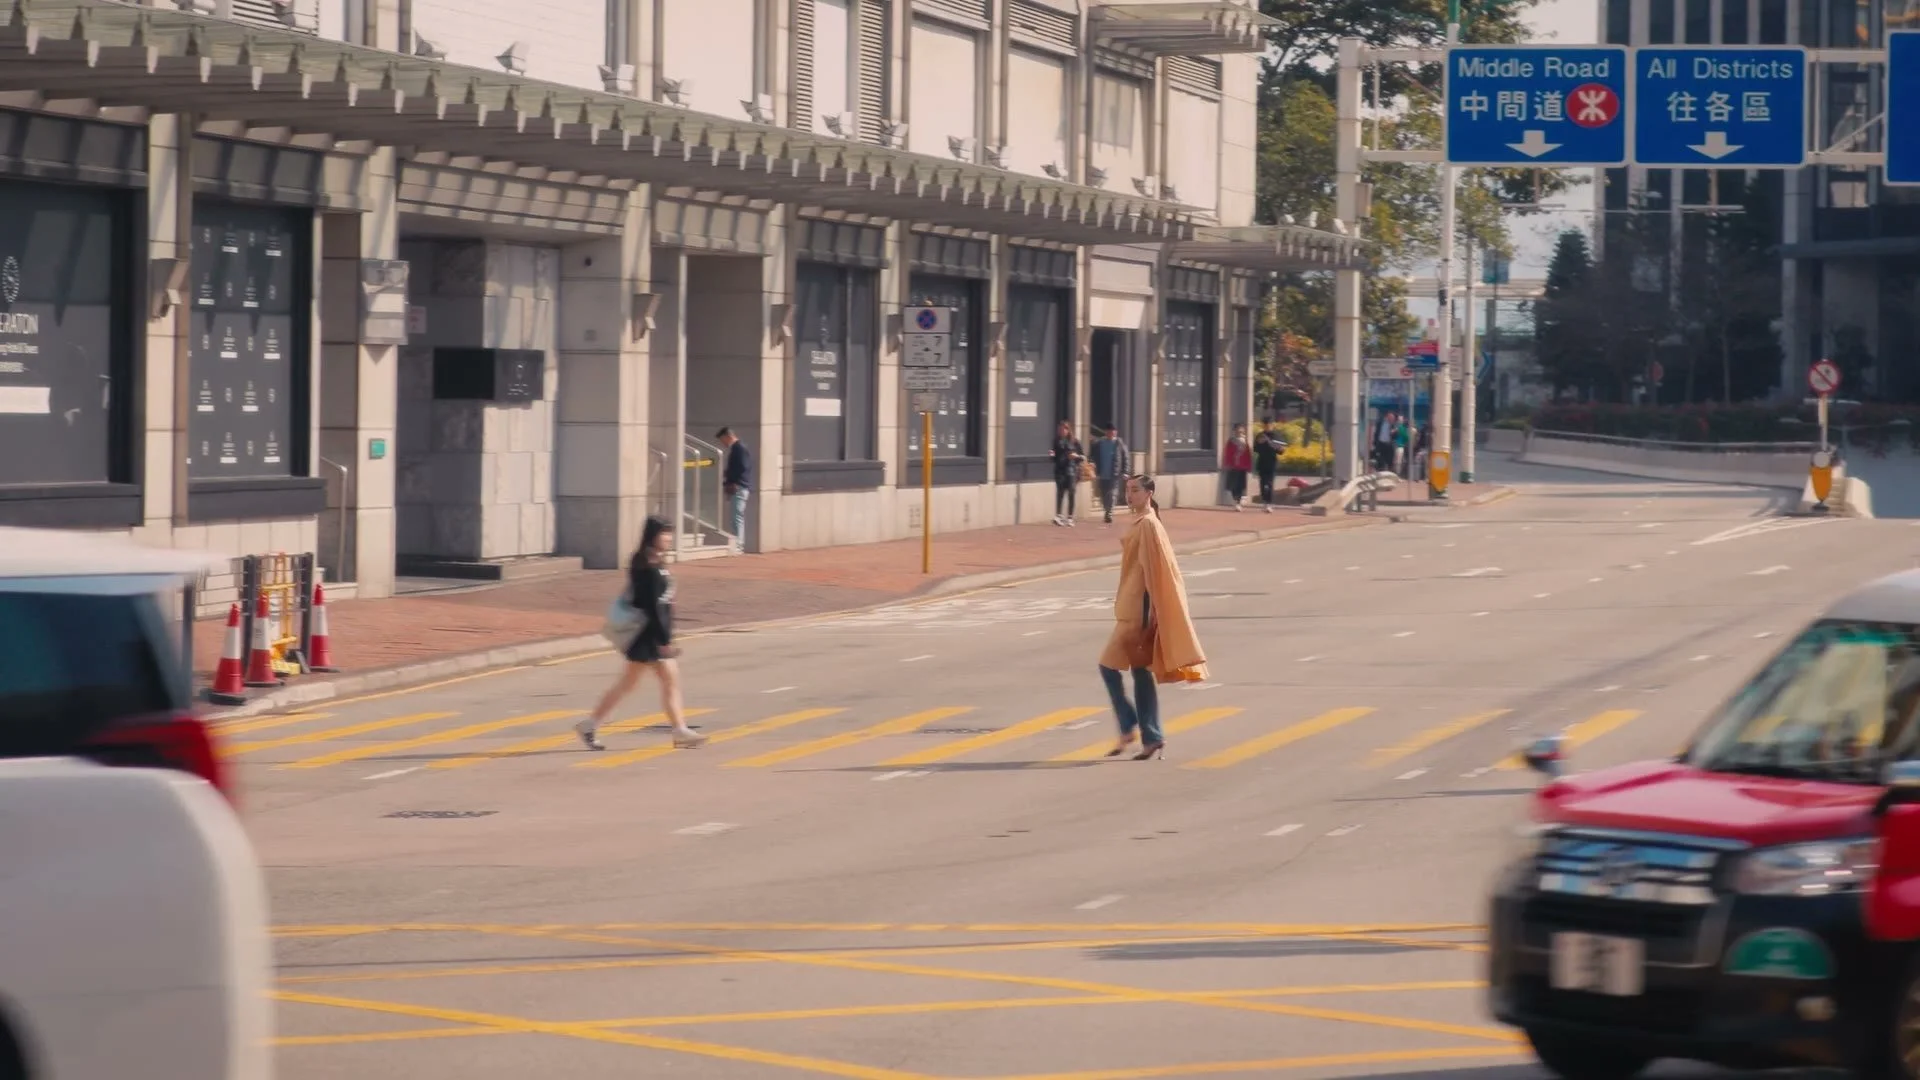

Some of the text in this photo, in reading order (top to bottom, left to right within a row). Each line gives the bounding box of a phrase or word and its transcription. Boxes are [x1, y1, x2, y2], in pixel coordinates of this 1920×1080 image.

[1458, 57, 1610, 79] Middle Road
[1647, 57, 1793, 80] All Districts
[1460, 90, 1564, 121] 中間道
[1667, 91, 1771, 122] 往各區
